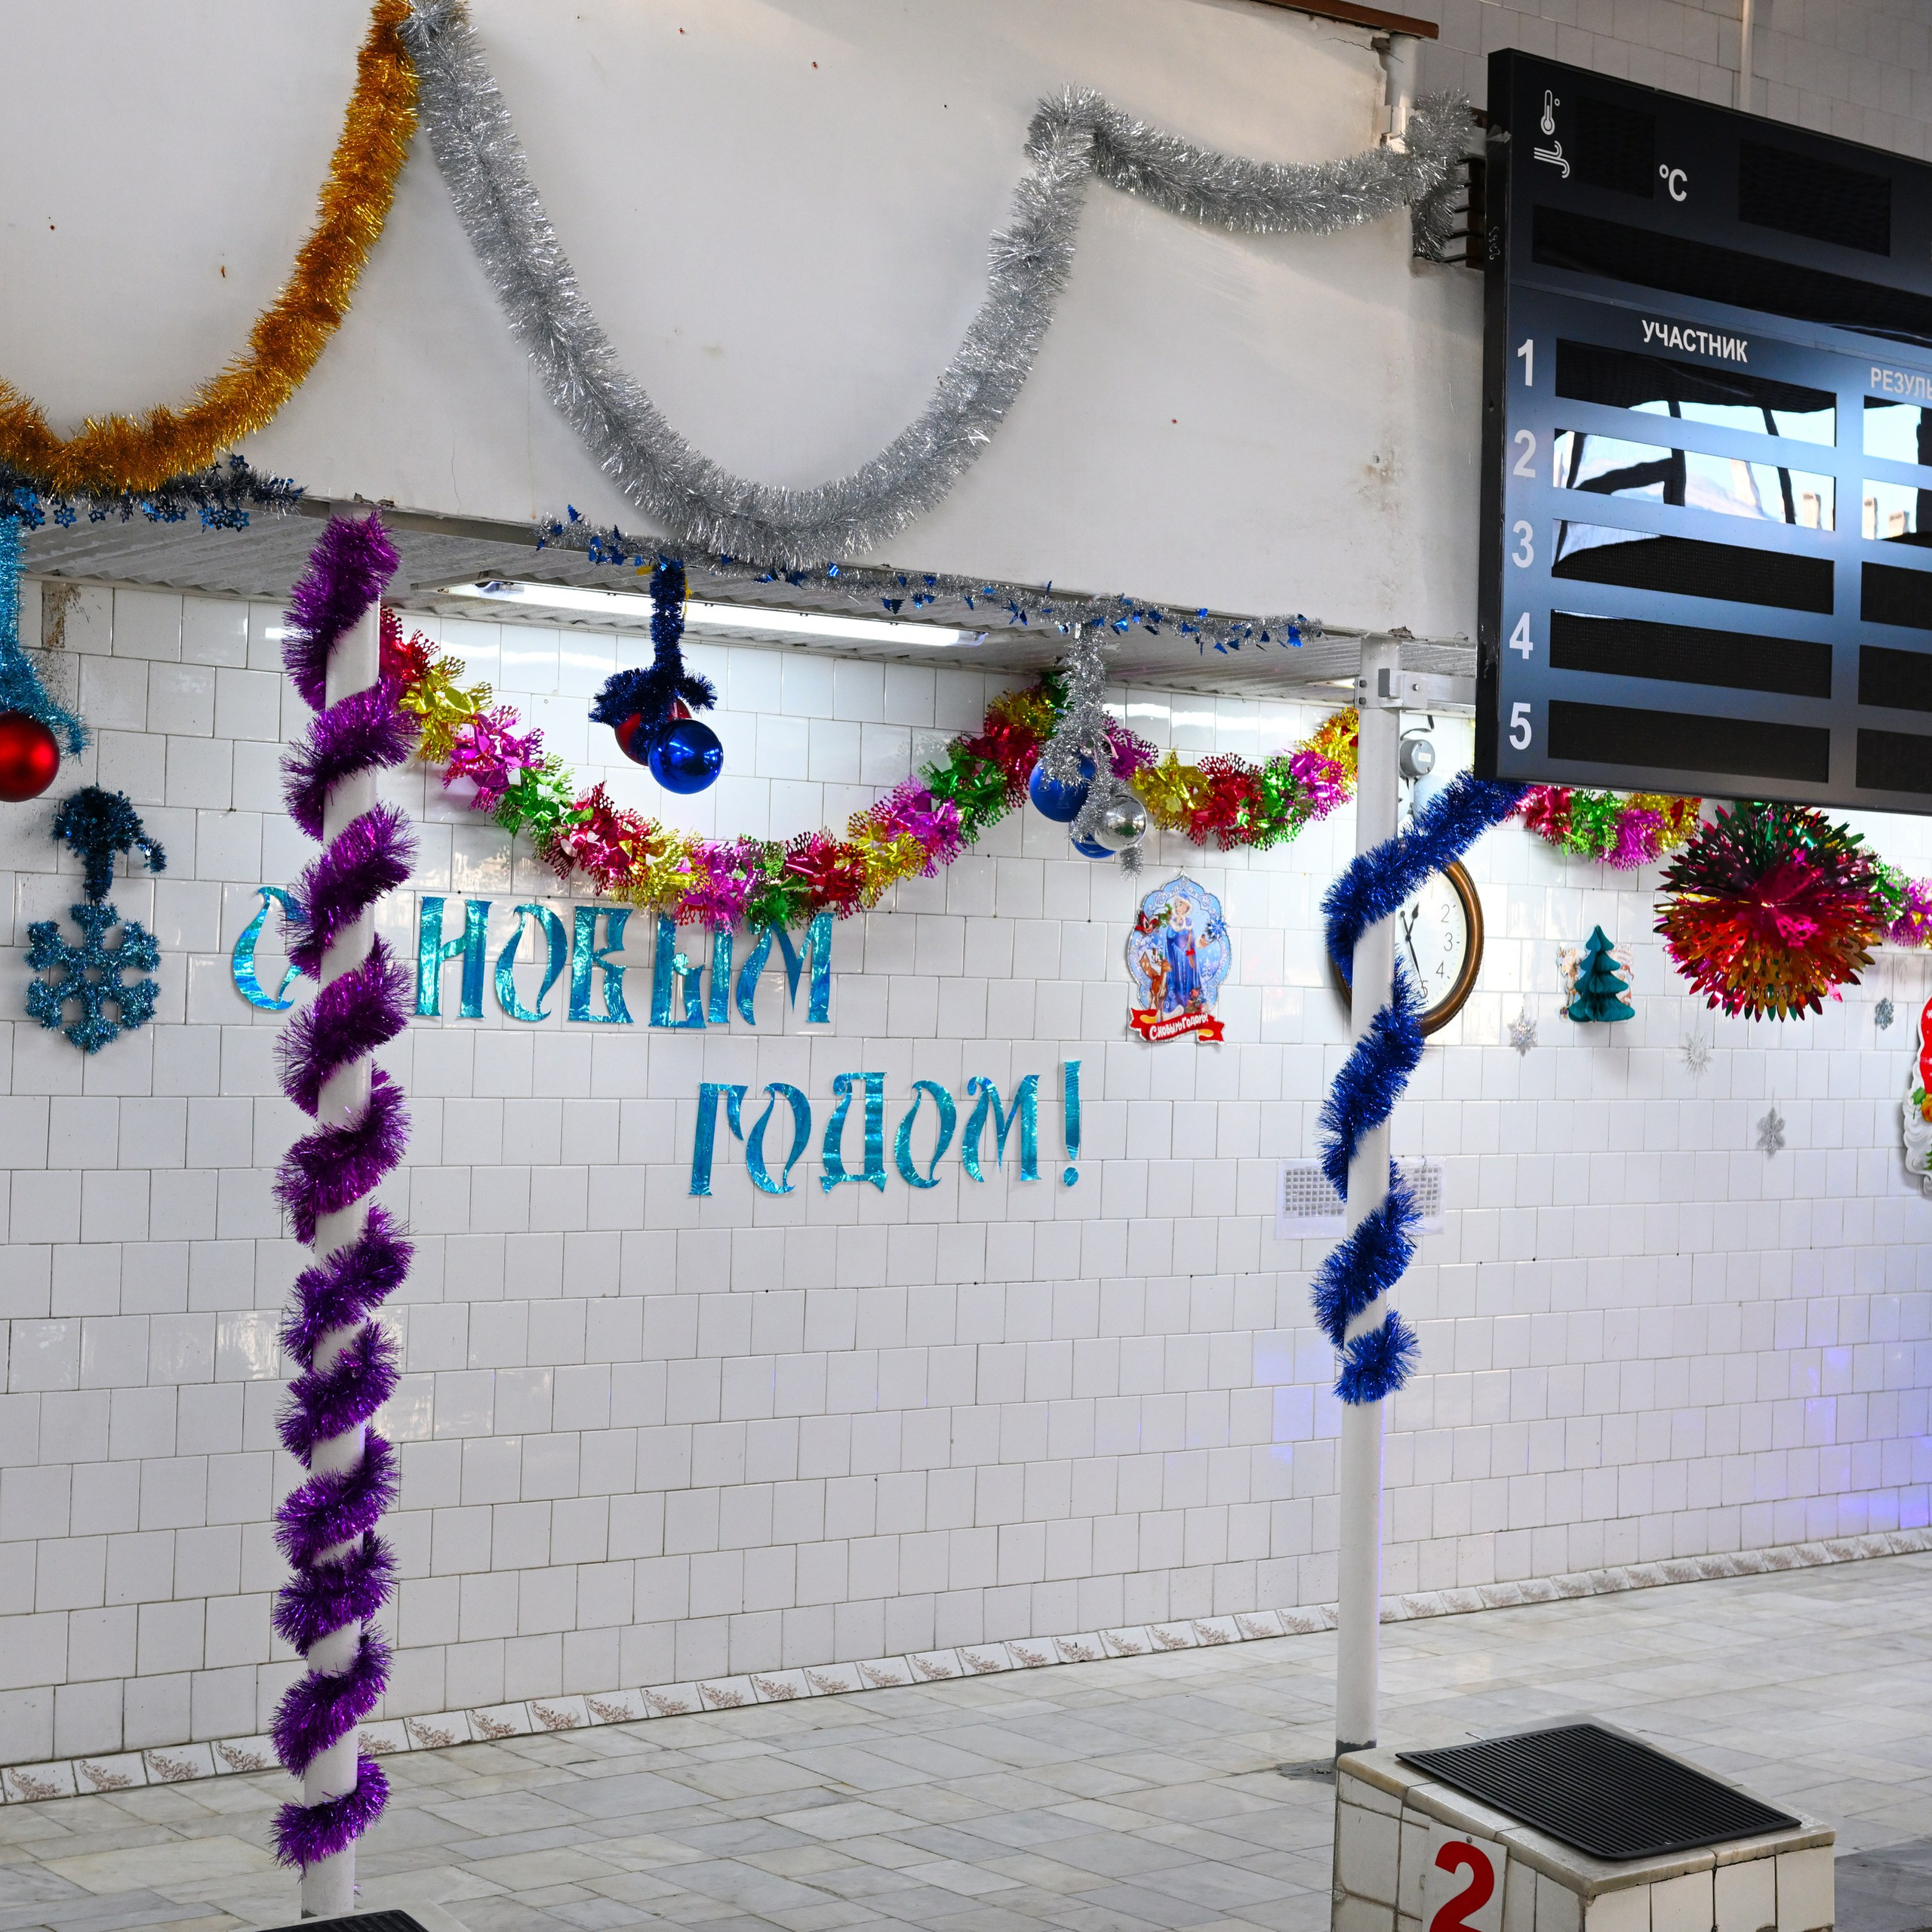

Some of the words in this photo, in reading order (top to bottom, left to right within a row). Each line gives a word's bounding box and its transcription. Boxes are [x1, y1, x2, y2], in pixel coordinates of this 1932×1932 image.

[1517, 338, 1534, 387] 1
[1641, 318, 1748, 363] УЧАСТНИК
[1513, 429, 1537, 478] 2
[1512, 520, 1534, 569] 3
[1509, 611, 1534, 660] 4
[1509, 703, 1532, 750] 5
[1440, 903, 1451, 923] 2
[414, 896, 835, 1029] НОВЫМ
[1443, 932, 1454, 952] 3
[1420, 980, 1429, 999] 5
[1435, 960, 1445, 979] 4
[1149, 1025, 1158, 1041] С
[688, 1060, 1082, 1197] ГОДОМ!
[1429, 1841, 1495, 1932] 2
